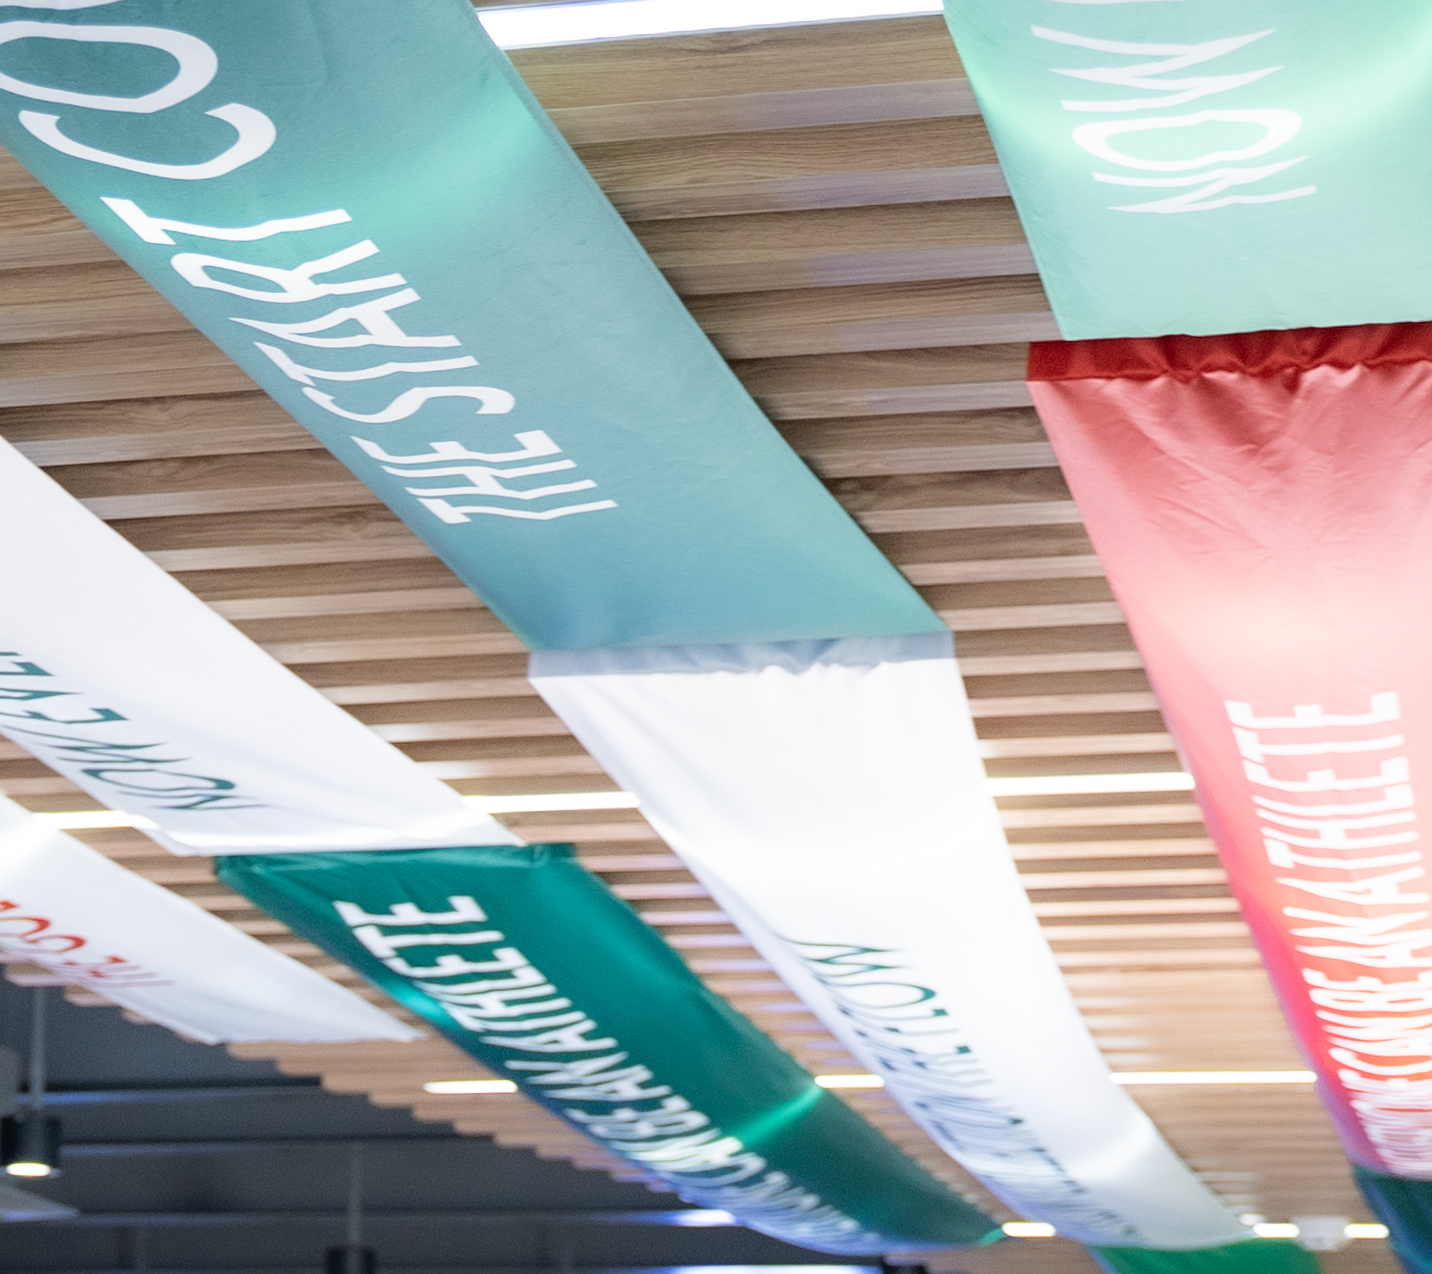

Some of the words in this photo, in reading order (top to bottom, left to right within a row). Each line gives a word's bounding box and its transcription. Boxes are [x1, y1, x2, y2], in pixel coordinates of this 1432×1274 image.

[1033, 26, 1317, 214] NOW
[100, 197, 515, 424] START
[350, 429, 618, 524] THE
[2, 724, 272, 811] NOW
[1225, 691, 1429, 902] ATHLETE
[334, 896, 618, 1052] ATHLETE
